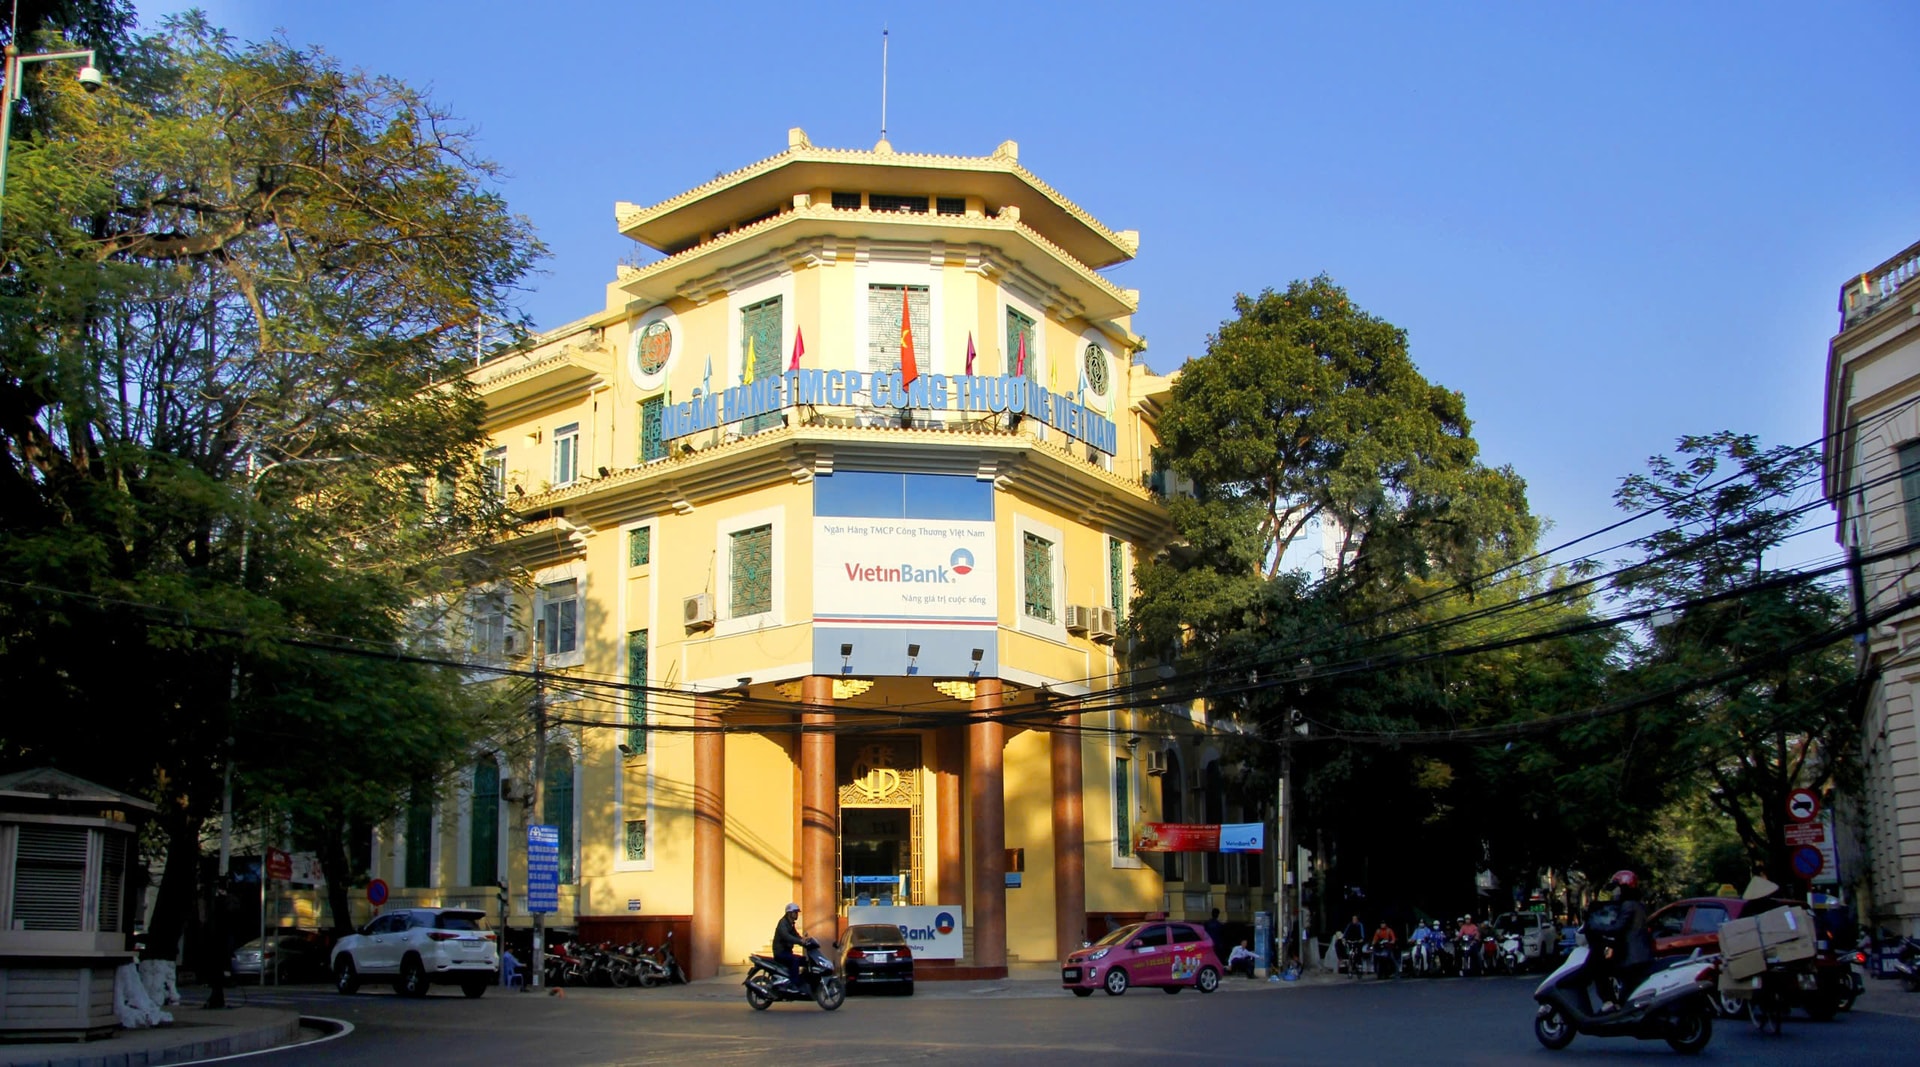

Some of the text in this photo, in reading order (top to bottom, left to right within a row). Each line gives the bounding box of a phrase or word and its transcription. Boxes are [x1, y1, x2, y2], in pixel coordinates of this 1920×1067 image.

[661, 362, 1117, 457] NGÂN HÀNG TMCP CÔNG THƯƠNG VIỆT NAM
[823, 525, 845, 534] Ngân
[847, 525, 868, 536] Hàng
[870, 526, 894, 535] TMCP
[896, 527, 916, 537] Công
[949, 528, 966, 539] Việt
[967, 529, 985, 538] Nam
[844, 562, 950, 584] VietinBank
[924, 595, 936, 604] giá
[937, 595, 947, 604] trị
[948, 595, 967, 604] cuộc
[968, 595, 987, 605] sống
